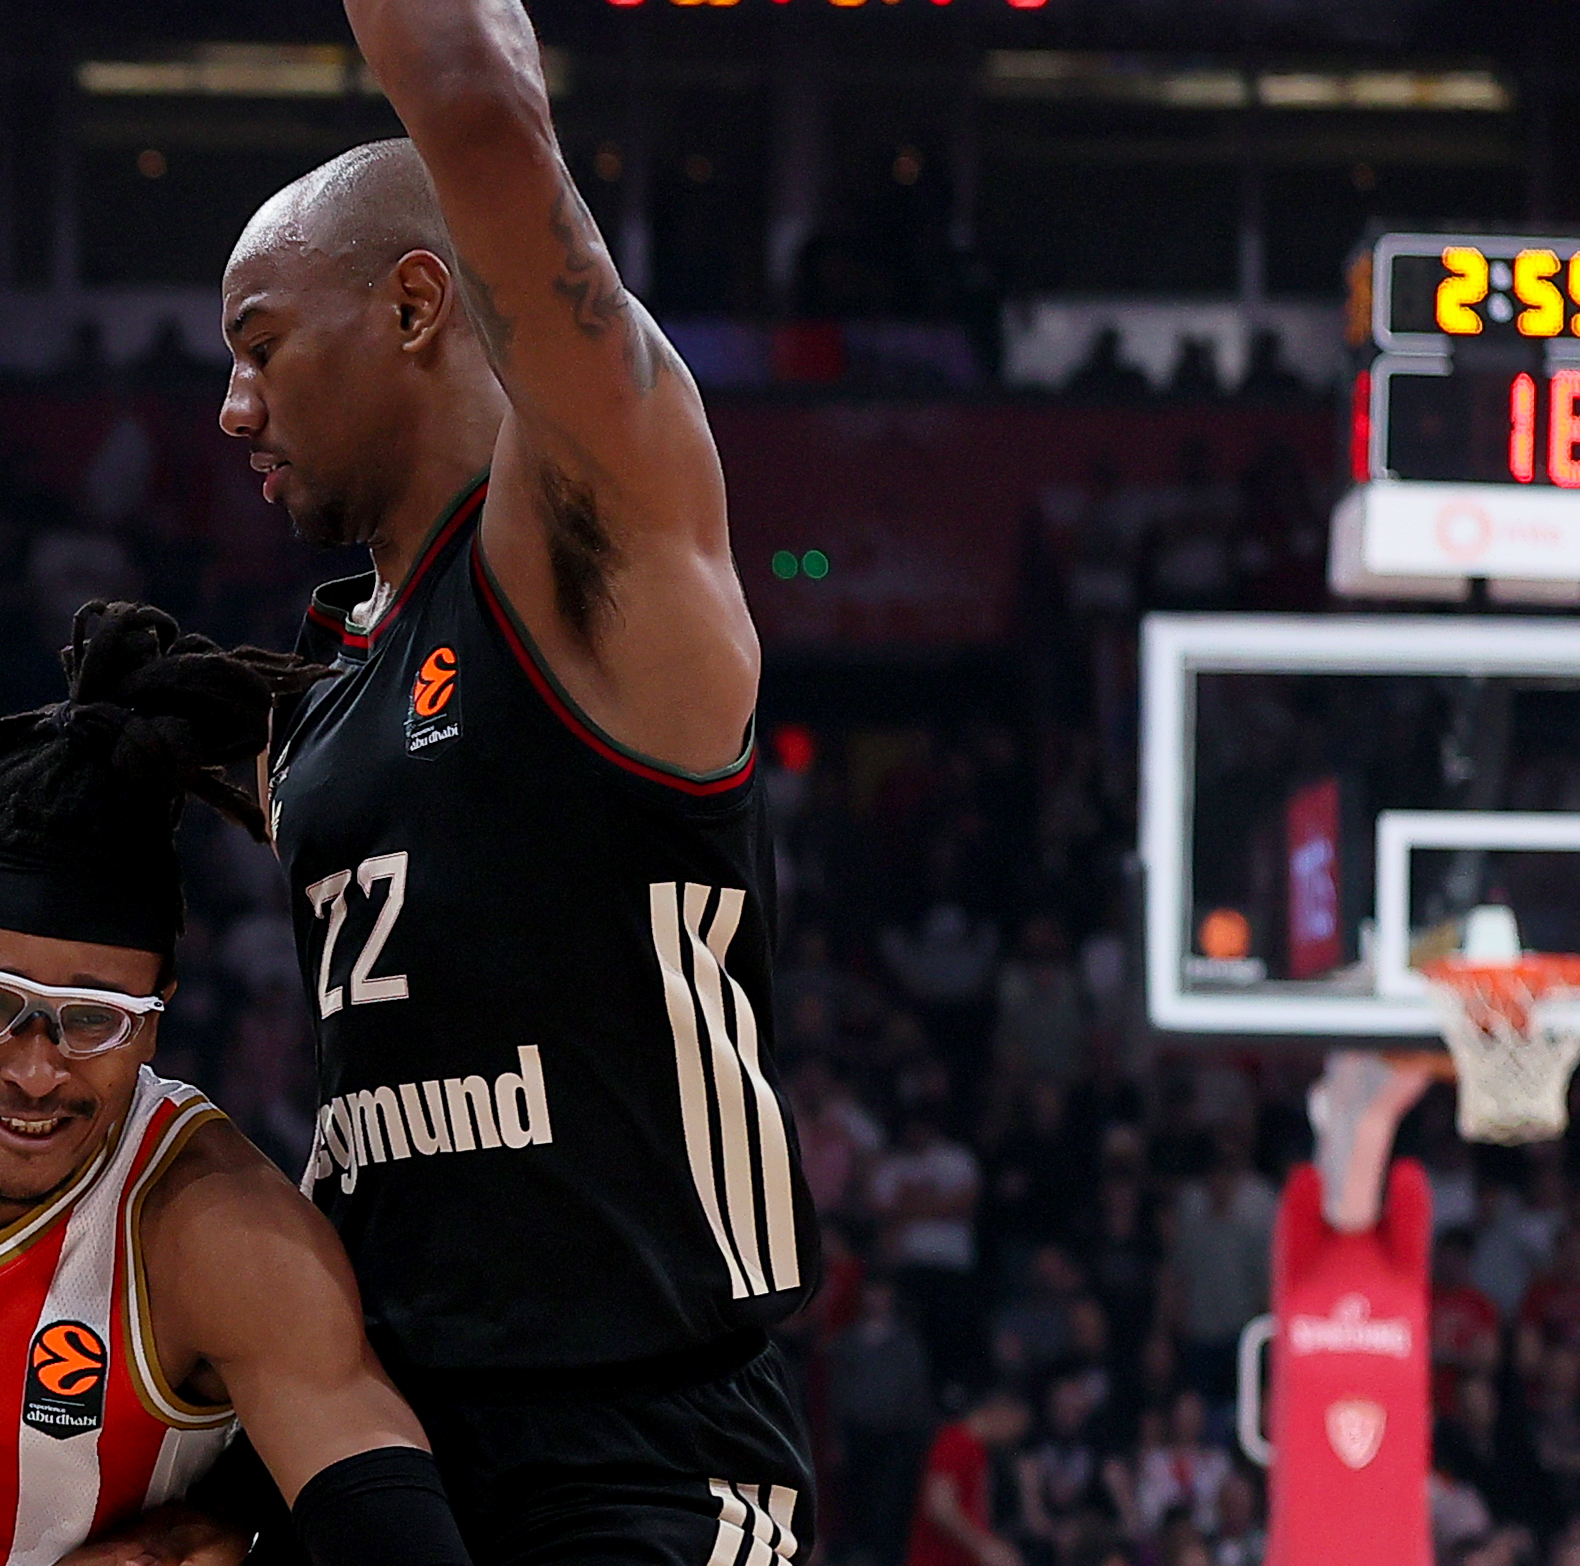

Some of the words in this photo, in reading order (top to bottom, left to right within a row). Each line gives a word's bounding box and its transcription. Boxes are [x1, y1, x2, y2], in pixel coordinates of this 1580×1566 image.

[1437, 246, 1580, 337] 2:5
[305, 851, 409, 1020] 22
[26, 1410, 54, 1424] abu
[56, 1413, 97, 1426] dhabi
